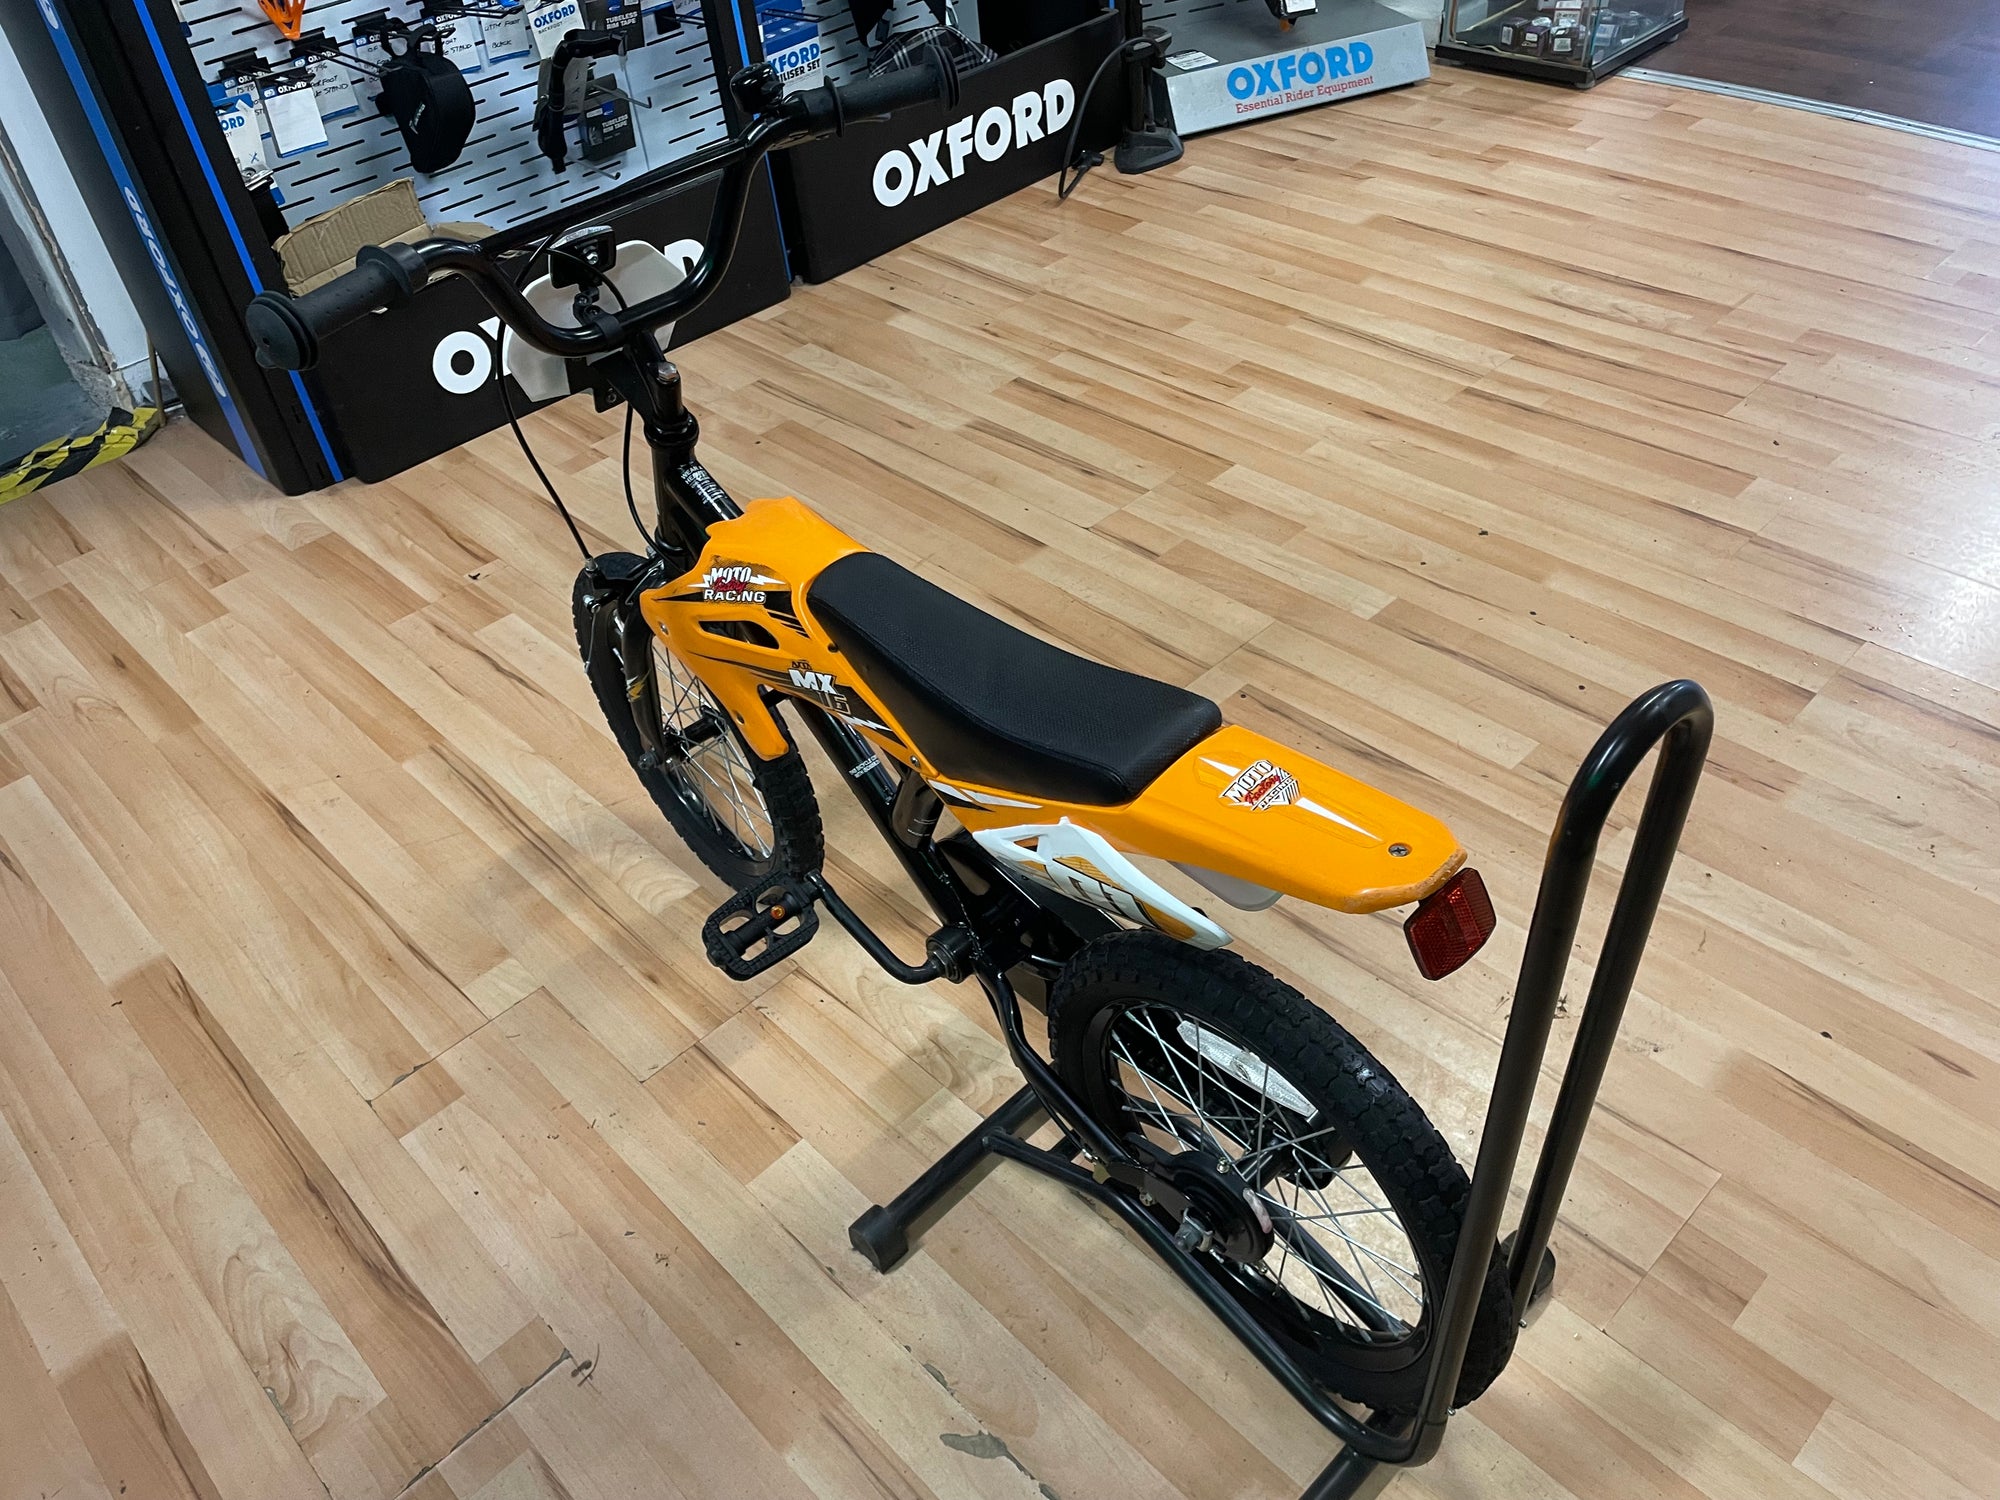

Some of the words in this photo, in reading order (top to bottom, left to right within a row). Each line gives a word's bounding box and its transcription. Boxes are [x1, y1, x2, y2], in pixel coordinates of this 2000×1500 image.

[534, 4, 576, 28] OXFORD
[605, 11, 638, 23] TUBELESS
[606, 21, 620, 30] RIM
[621, 17, 636, 27] TAPE
[768, 43, 820, 73] XFORD
[807, 59, 821, 72] SET
[1227, 41, 1374, 100] OXFORD
[1235, 94, 1283, 114] Essential
[1285, 89, 1314, 103] Rider
[1317, 75, 1374, 96] Equipment
[602, 114, 629, 128] TUBELESS
[603, 126, 615, 134] RIM
[614, 120, 628, 130] TAPE
[872, 78, 1075, 207] OXFORD
[710, 566, 752, 584] MOTO
[704, 588, 767, 603] RACING
[788, 668, 837, 695] MX
[1222, 760, 1274, 803] MOTO
